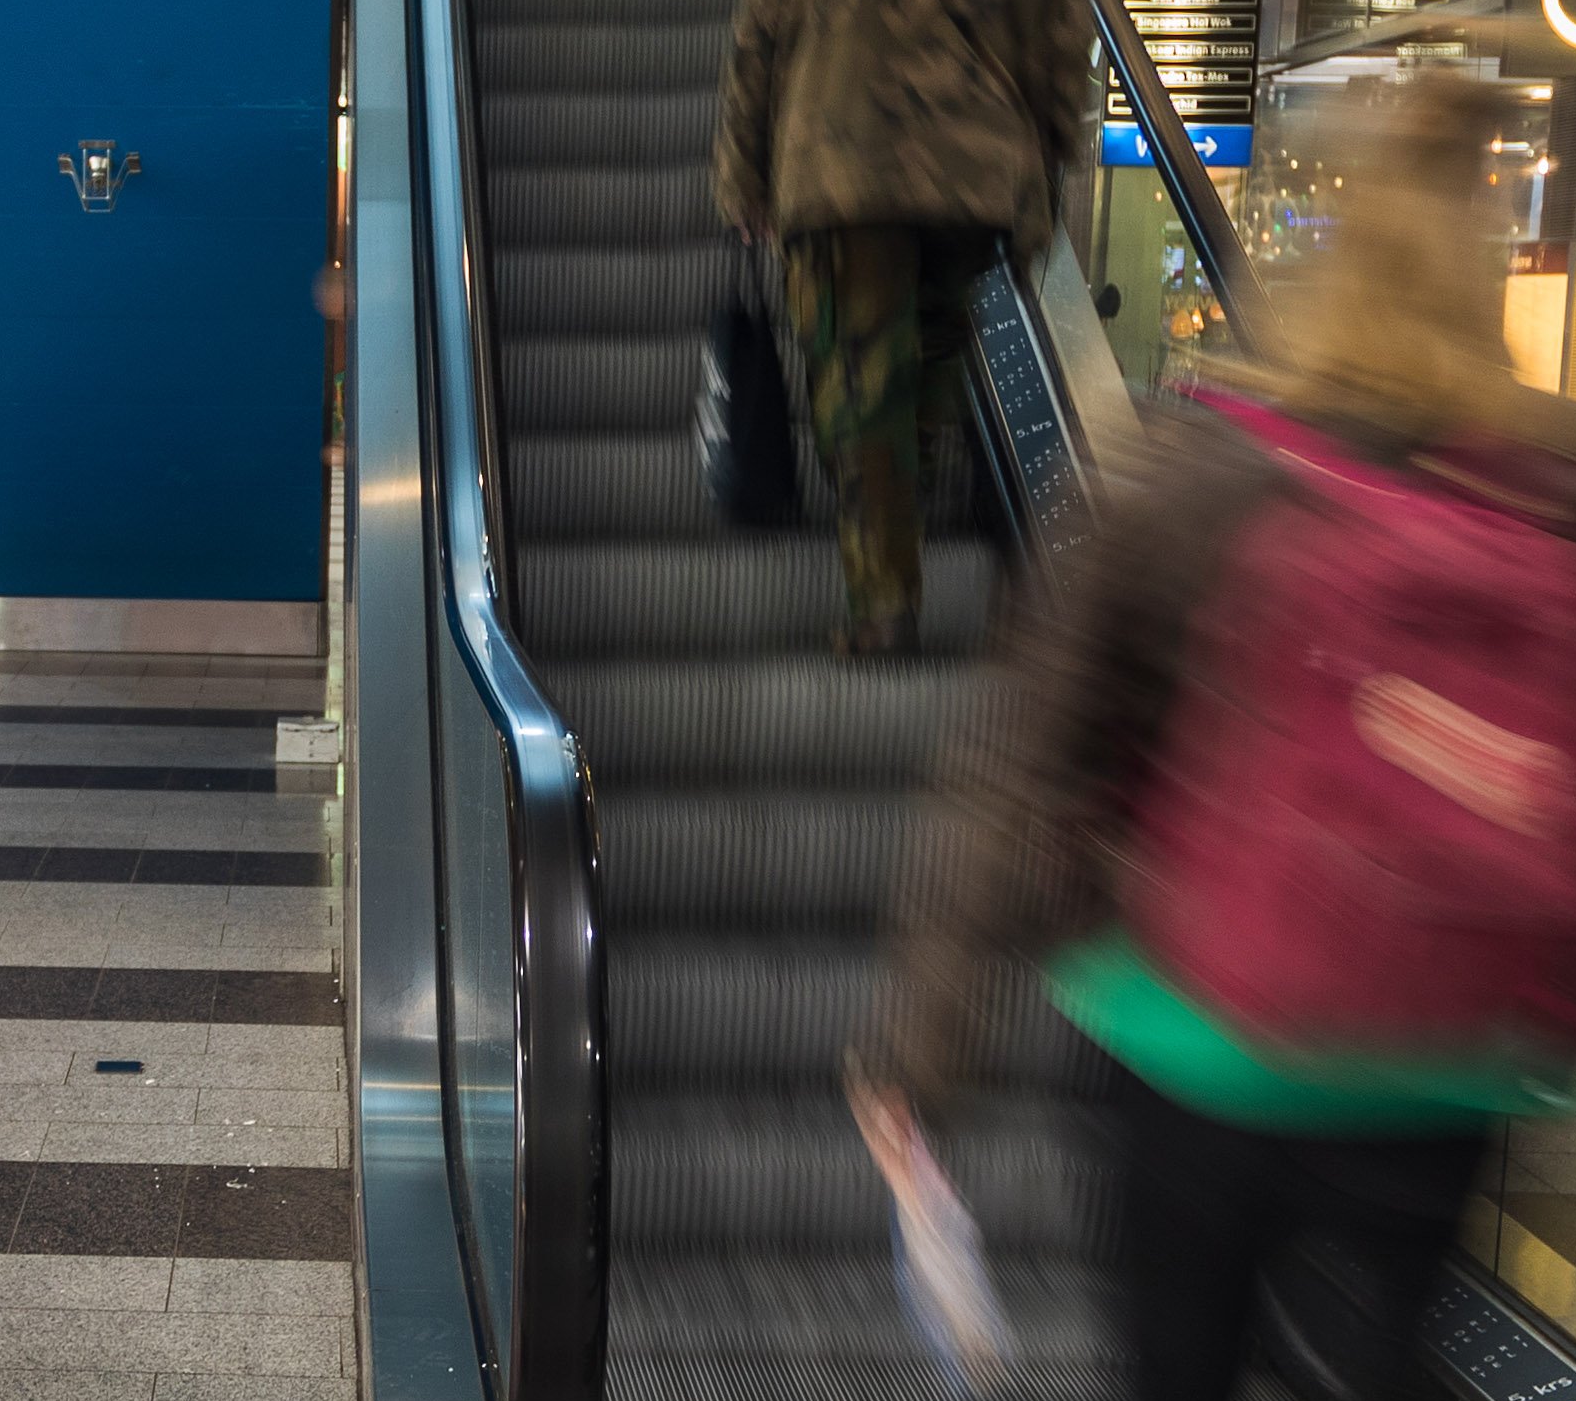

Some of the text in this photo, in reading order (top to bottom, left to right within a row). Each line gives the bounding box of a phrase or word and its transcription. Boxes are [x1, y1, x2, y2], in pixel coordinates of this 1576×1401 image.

[1210, 44, 1250, 58] Express
[1031, 420, 1053, 433] krs
[1533, 1376, 1573, 1396] krs
